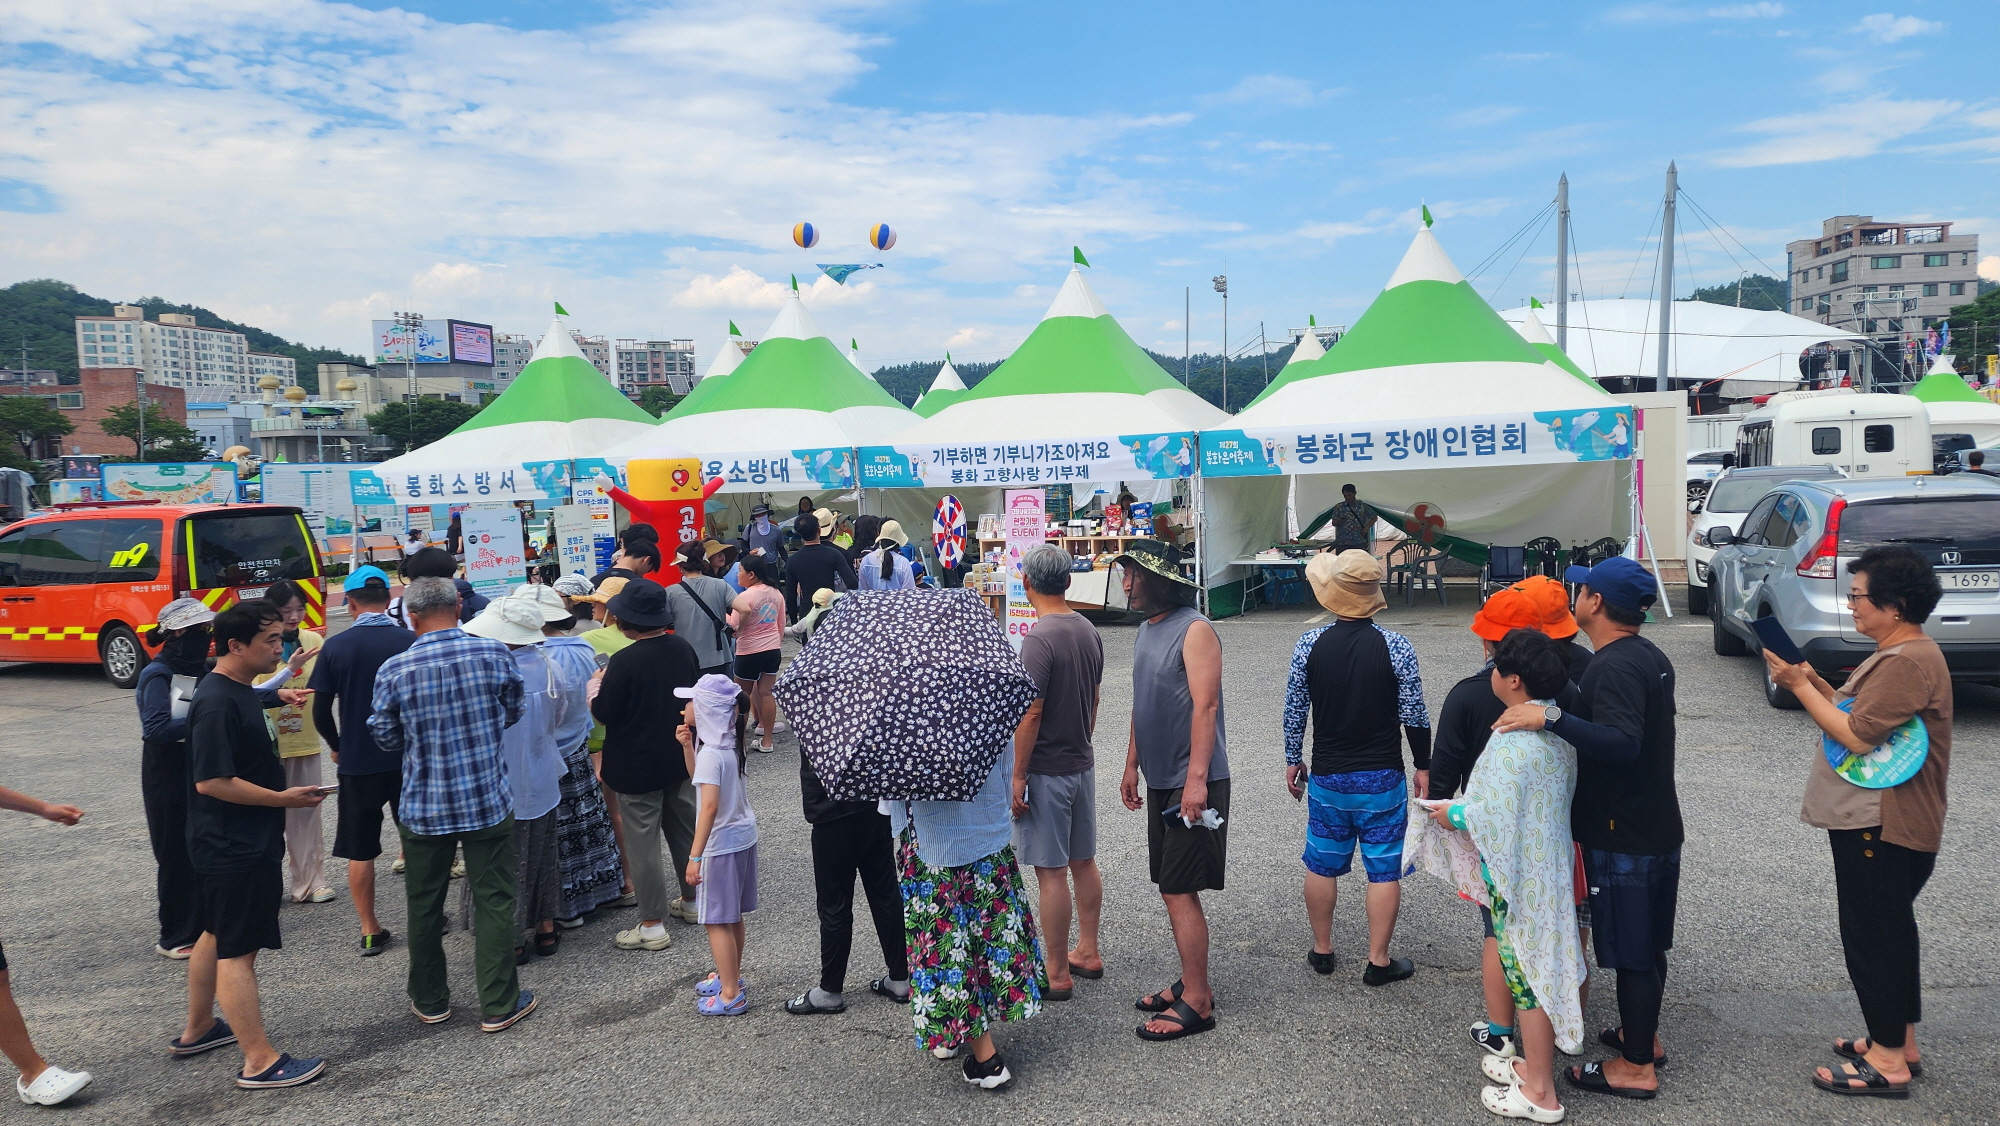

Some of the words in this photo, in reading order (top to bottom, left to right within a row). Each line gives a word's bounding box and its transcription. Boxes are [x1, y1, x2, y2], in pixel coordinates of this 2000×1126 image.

[1219, 440, 1239, 449] 제27회
[1295, 432, 1374, 464] 봉화군
[1385, 422, 1527, 460] 장애인협회
[874, 455, 891, 464] 제27회
[932, 446, 987, 466] 기부하면
[993, 441, 1111, 465] 기부니가조아져요
[1206, 449, 1254, 466] 봉화은어축제
[701, 457, 790, 485] 용소방대
[864, 463, 902, 478] 봉화은어축제
[951, 469, 978, 484] 봉화
[983, 466, 1040, 482] 고향사랑
[1046, 464, 1089, 481] 기부제
[406, 469, 516, 498] 봉화소방서
[567, 536, 584, 546] 봉화군
[1012, 528, 1040, 538] EVENT
[109, 543, 148, 568] 119
[237, 558, 282, 570] 안전진단차
[1951, 574, 1990, 587] 1699
